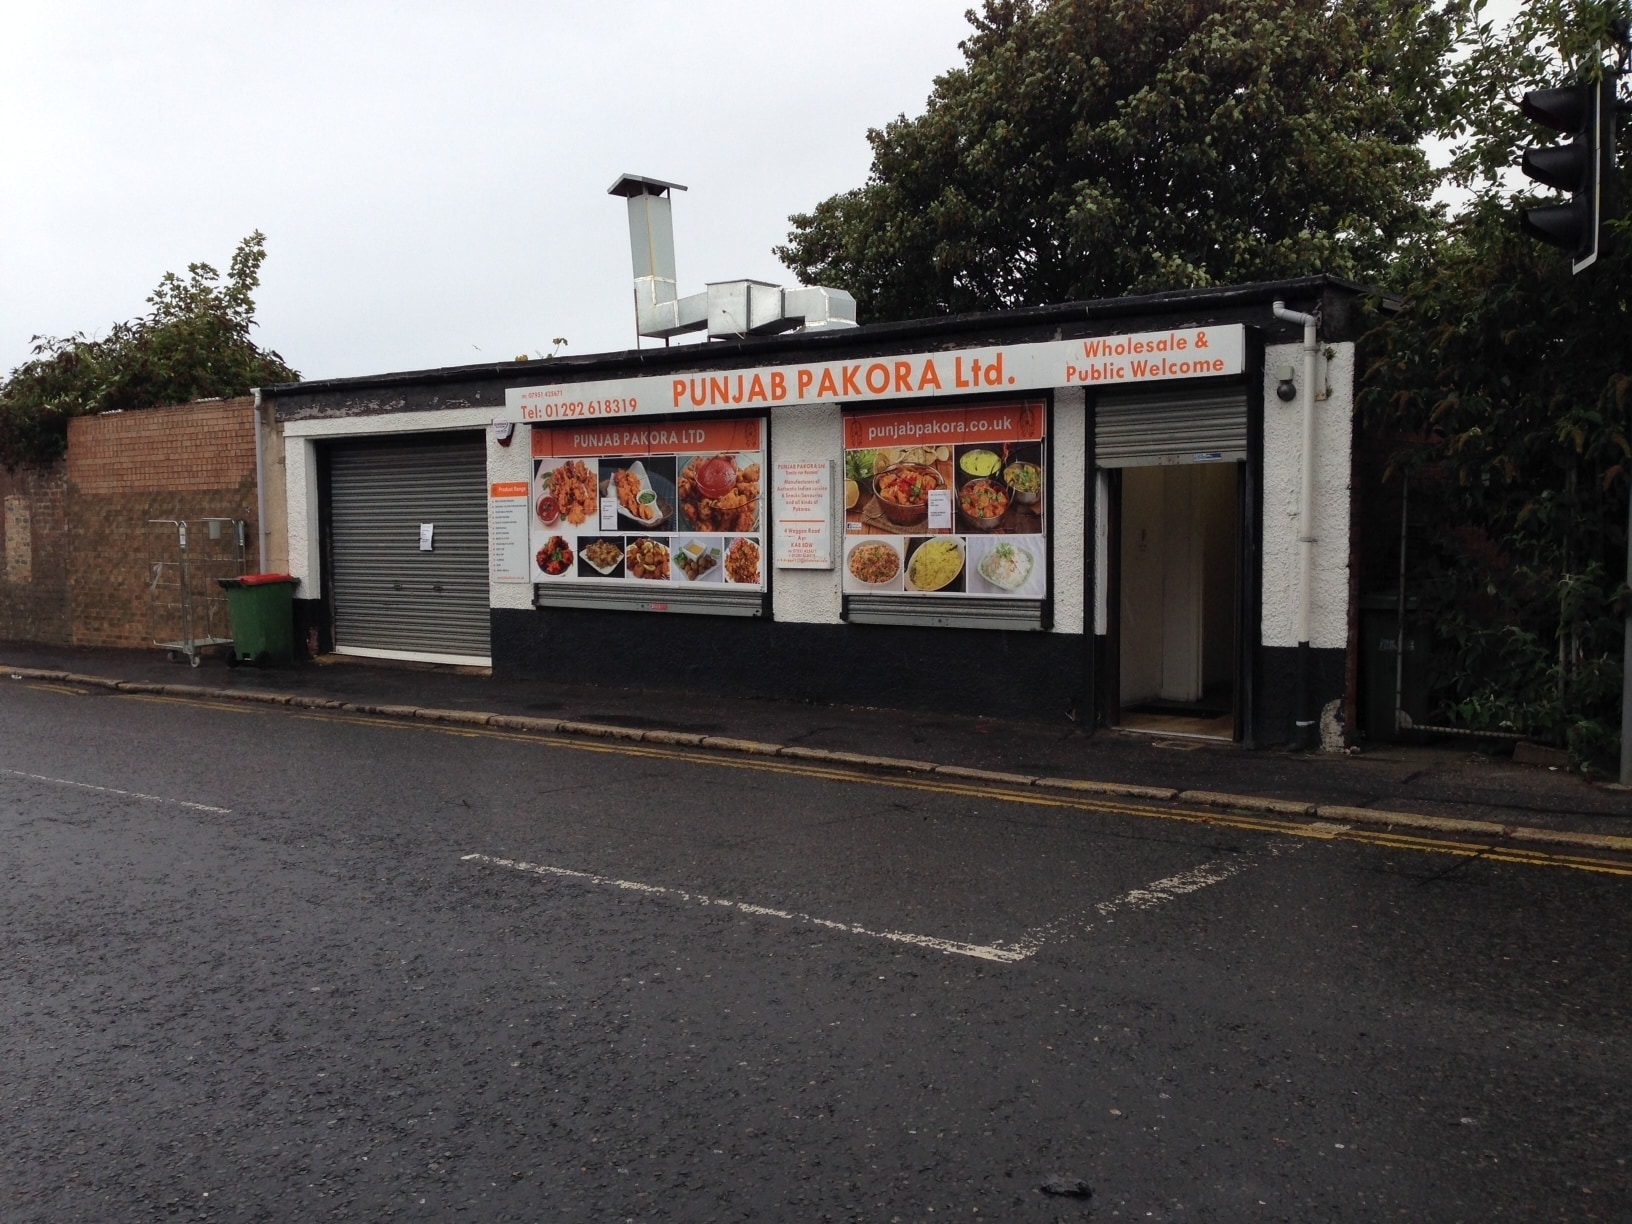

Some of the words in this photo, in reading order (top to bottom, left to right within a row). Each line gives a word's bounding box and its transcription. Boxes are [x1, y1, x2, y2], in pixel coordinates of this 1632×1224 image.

[1083, 333, 1188, 358] Wholesale
[1194, 331, 1209, 349] &
[672, 371, 788, 408] PUNJAB
[797, 358, 943, 400] PAKORA
[955, 352, 1016, 389] Ltd.
[1065, 362, 1125, 383] Public
[1130, 358, 1225, 378] Welcome
[520, 404, 543, 419] Tel:
[545, 401, 585, 418] 01292
[587, 397, 638, 415] 618319
[573, 432, 620, 448] PUNJAB
[623, 430, 679, 446] PAKORA
[682, 429, 706, 444] LTD
[868, 415, 1012, 441] punjabpakora.co.uk
